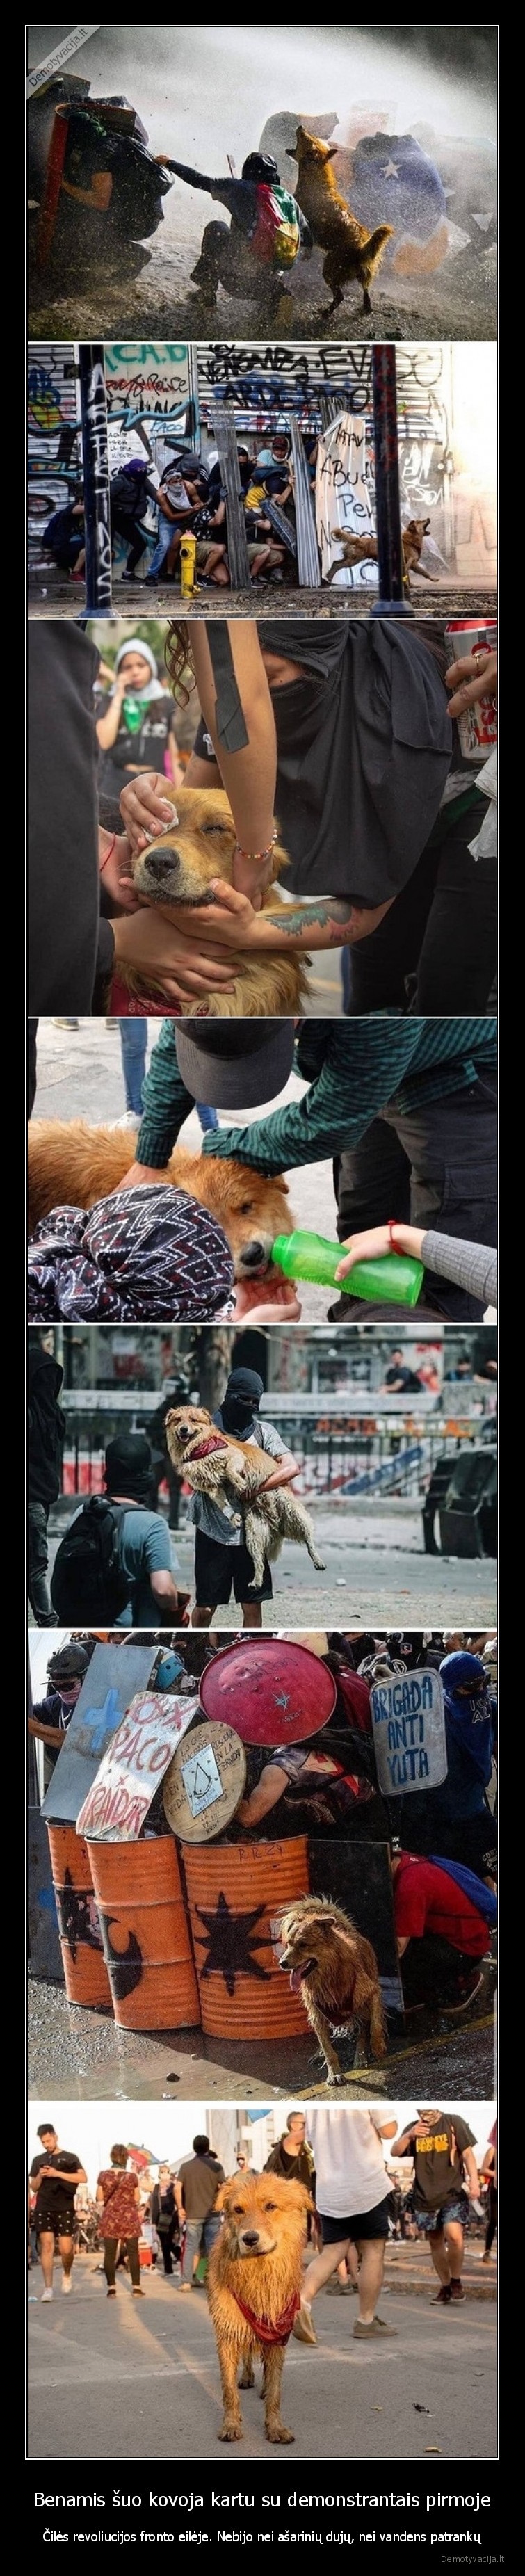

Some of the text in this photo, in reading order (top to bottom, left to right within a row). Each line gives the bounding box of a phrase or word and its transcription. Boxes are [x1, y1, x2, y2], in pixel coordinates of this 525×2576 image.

[372, 1675, 433, 1723] BRIGADA
[108, 1727, 171, 1773] PACO
[387, 1714, 424, 1750] ANTI
[387, 1748, 429, 1787] YUTA
